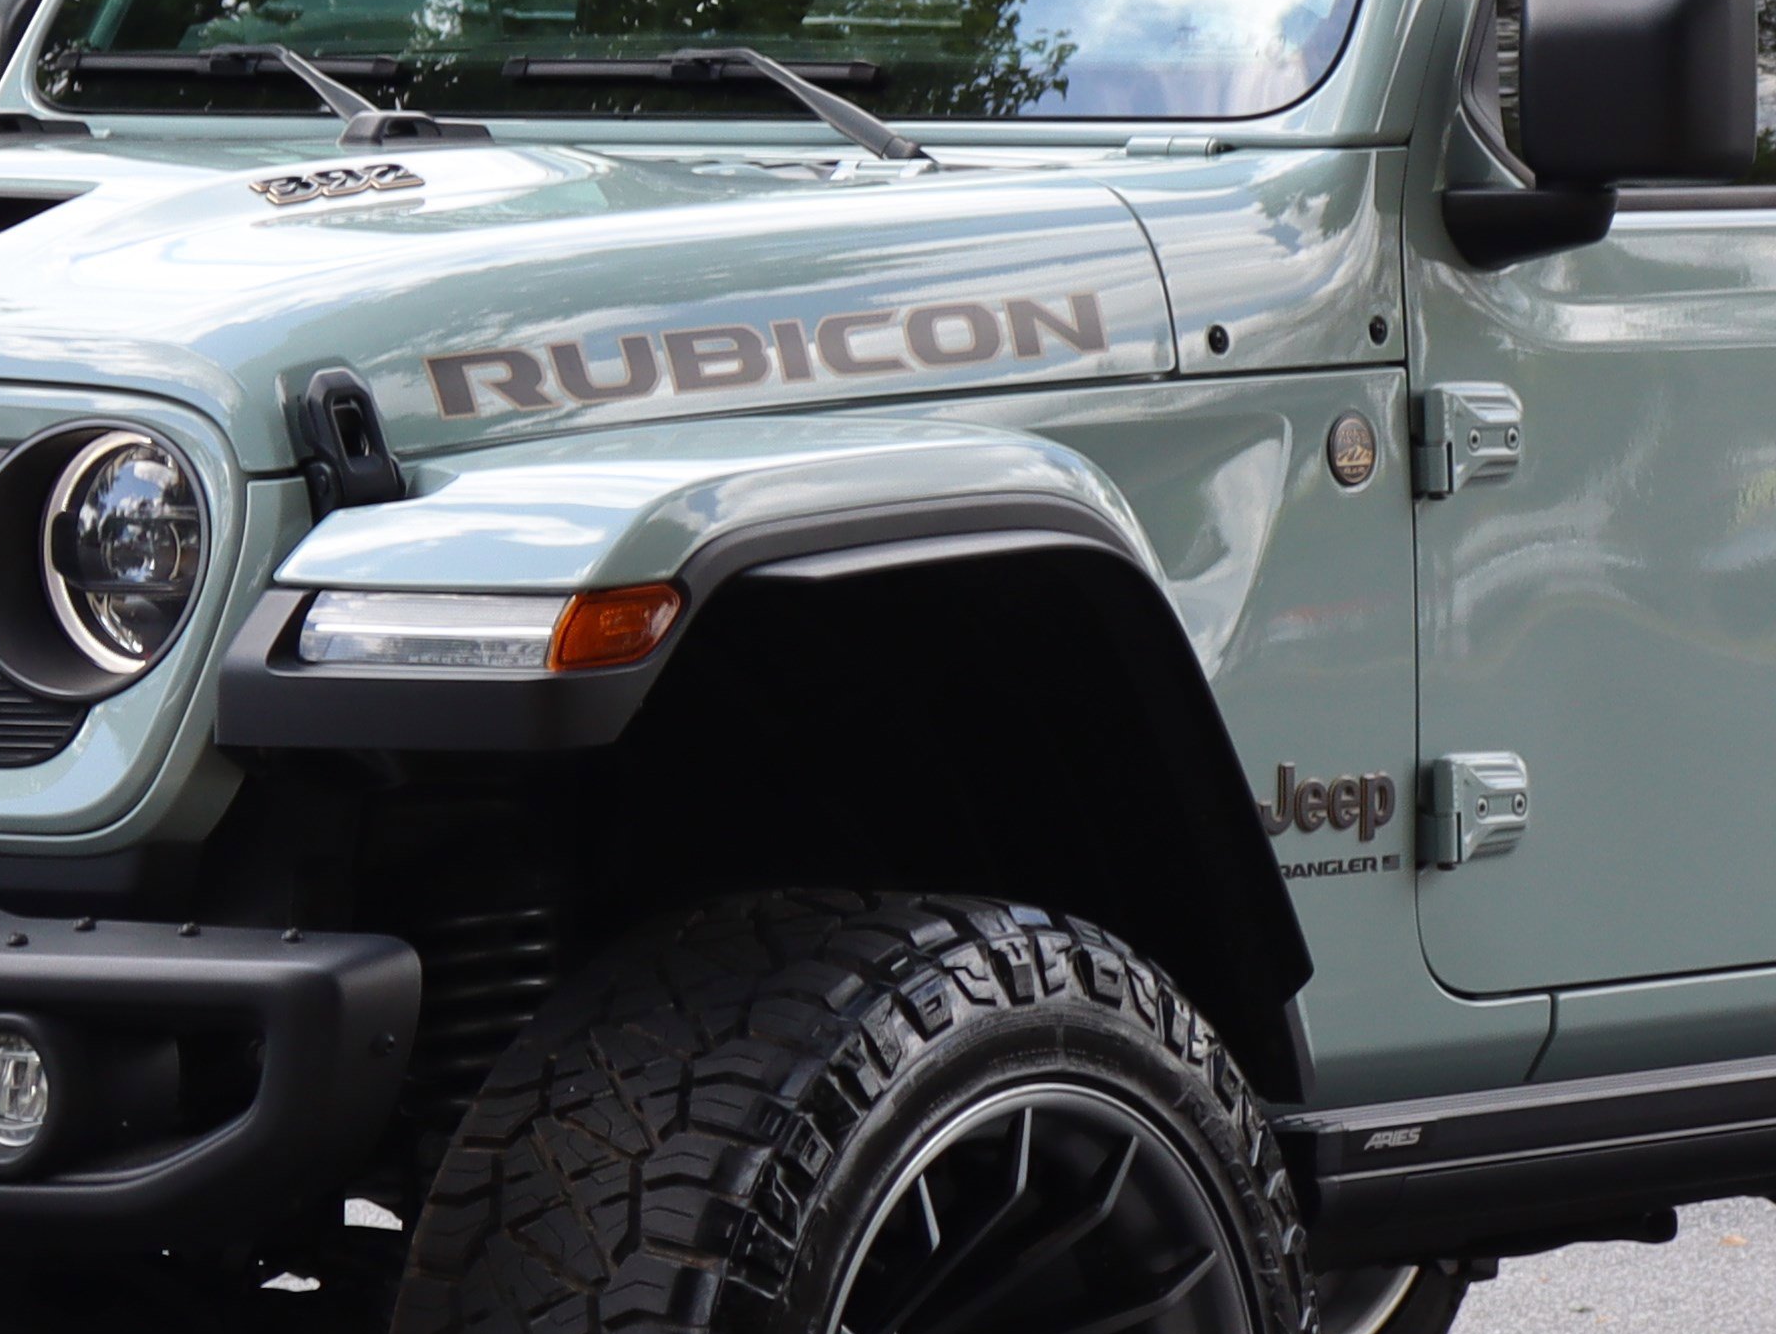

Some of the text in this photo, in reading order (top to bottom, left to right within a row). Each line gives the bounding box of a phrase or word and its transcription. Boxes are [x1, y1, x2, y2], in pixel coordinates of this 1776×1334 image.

[426, 293, 1109, 421] RUBICON
[1258, 761, 1395, 843] Jeep
[1279, 856, 1378, 880] RANGLER
[1364, 1127, 1422, 1151] ARIES
